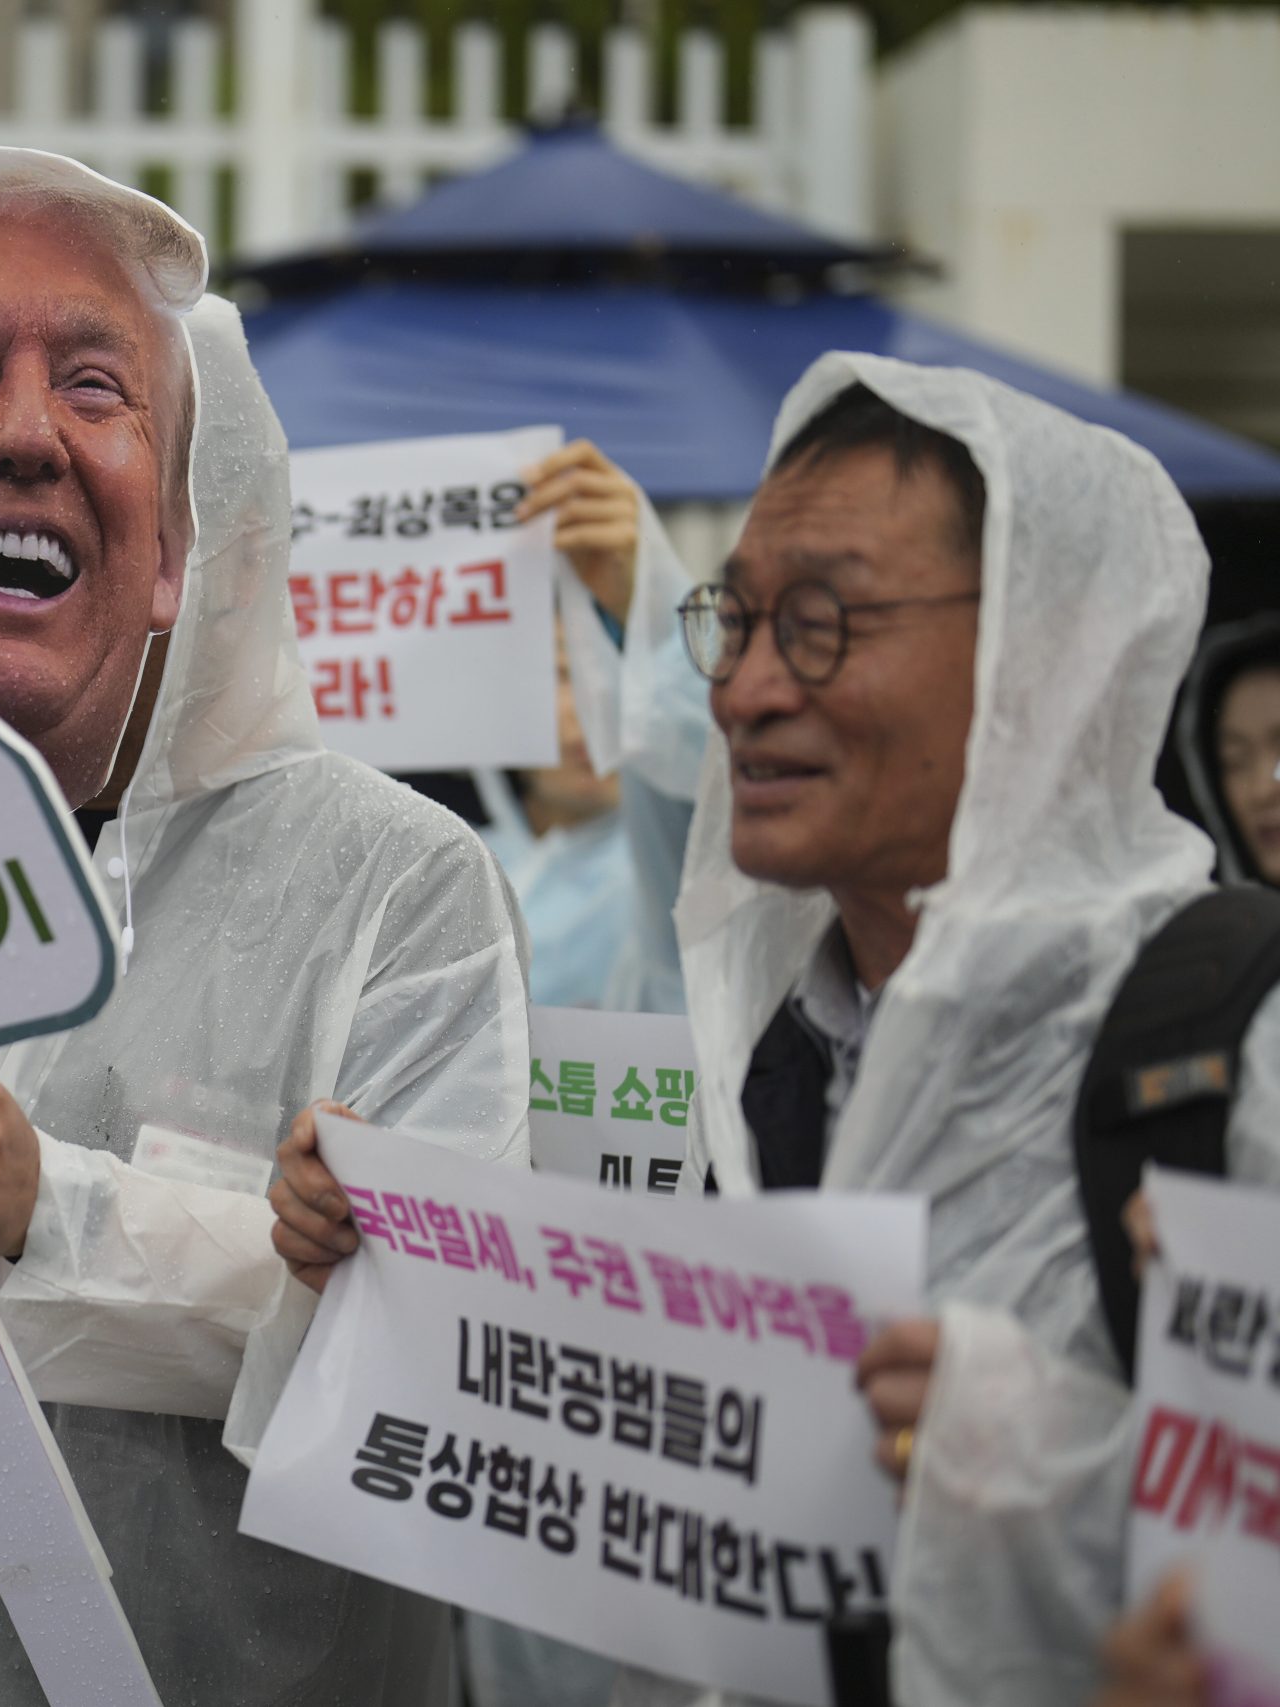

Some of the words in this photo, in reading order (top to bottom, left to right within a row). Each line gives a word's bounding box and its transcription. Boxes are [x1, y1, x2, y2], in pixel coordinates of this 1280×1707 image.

[610, 1065, 695, 1127] 쇼핑
[342, 1183, 538, 1292] 국민혈세,
[537, 1224, 646, 1315] 주권
[456, 1316, 764, 1487] 내란공범들의
[349, 1411, 585, 1556] 통상협상
